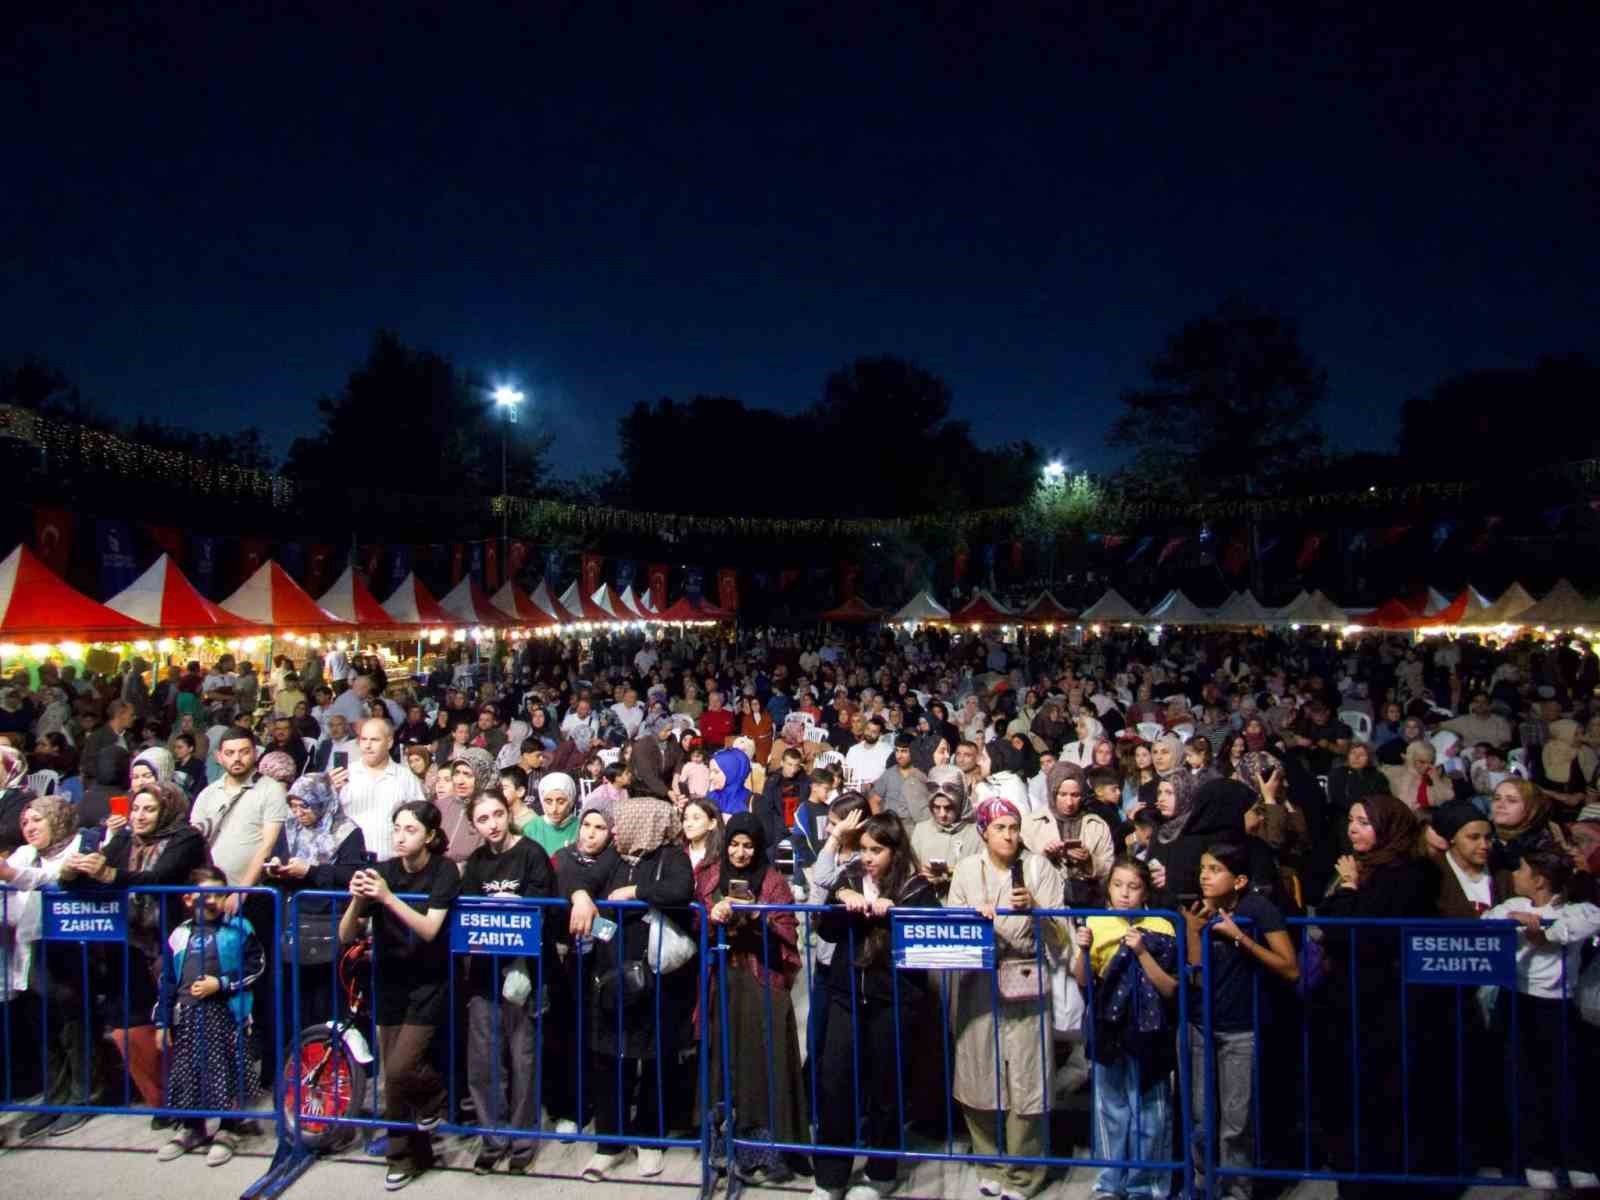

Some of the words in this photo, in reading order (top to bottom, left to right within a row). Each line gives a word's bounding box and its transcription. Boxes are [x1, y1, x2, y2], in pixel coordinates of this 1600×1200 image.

[53, 902, 119, 915] ESENLER
[60, 918, 114, 932] ZABITA
[460, 914, 532, 929] ESENLER
[467, 931, 524, 947] ZABITA
[903, 924, 983, 940] ESENLER
[1412, 936, 1502, 952] ESENLER
[1421, 957, 1492, 972] ZABITA
